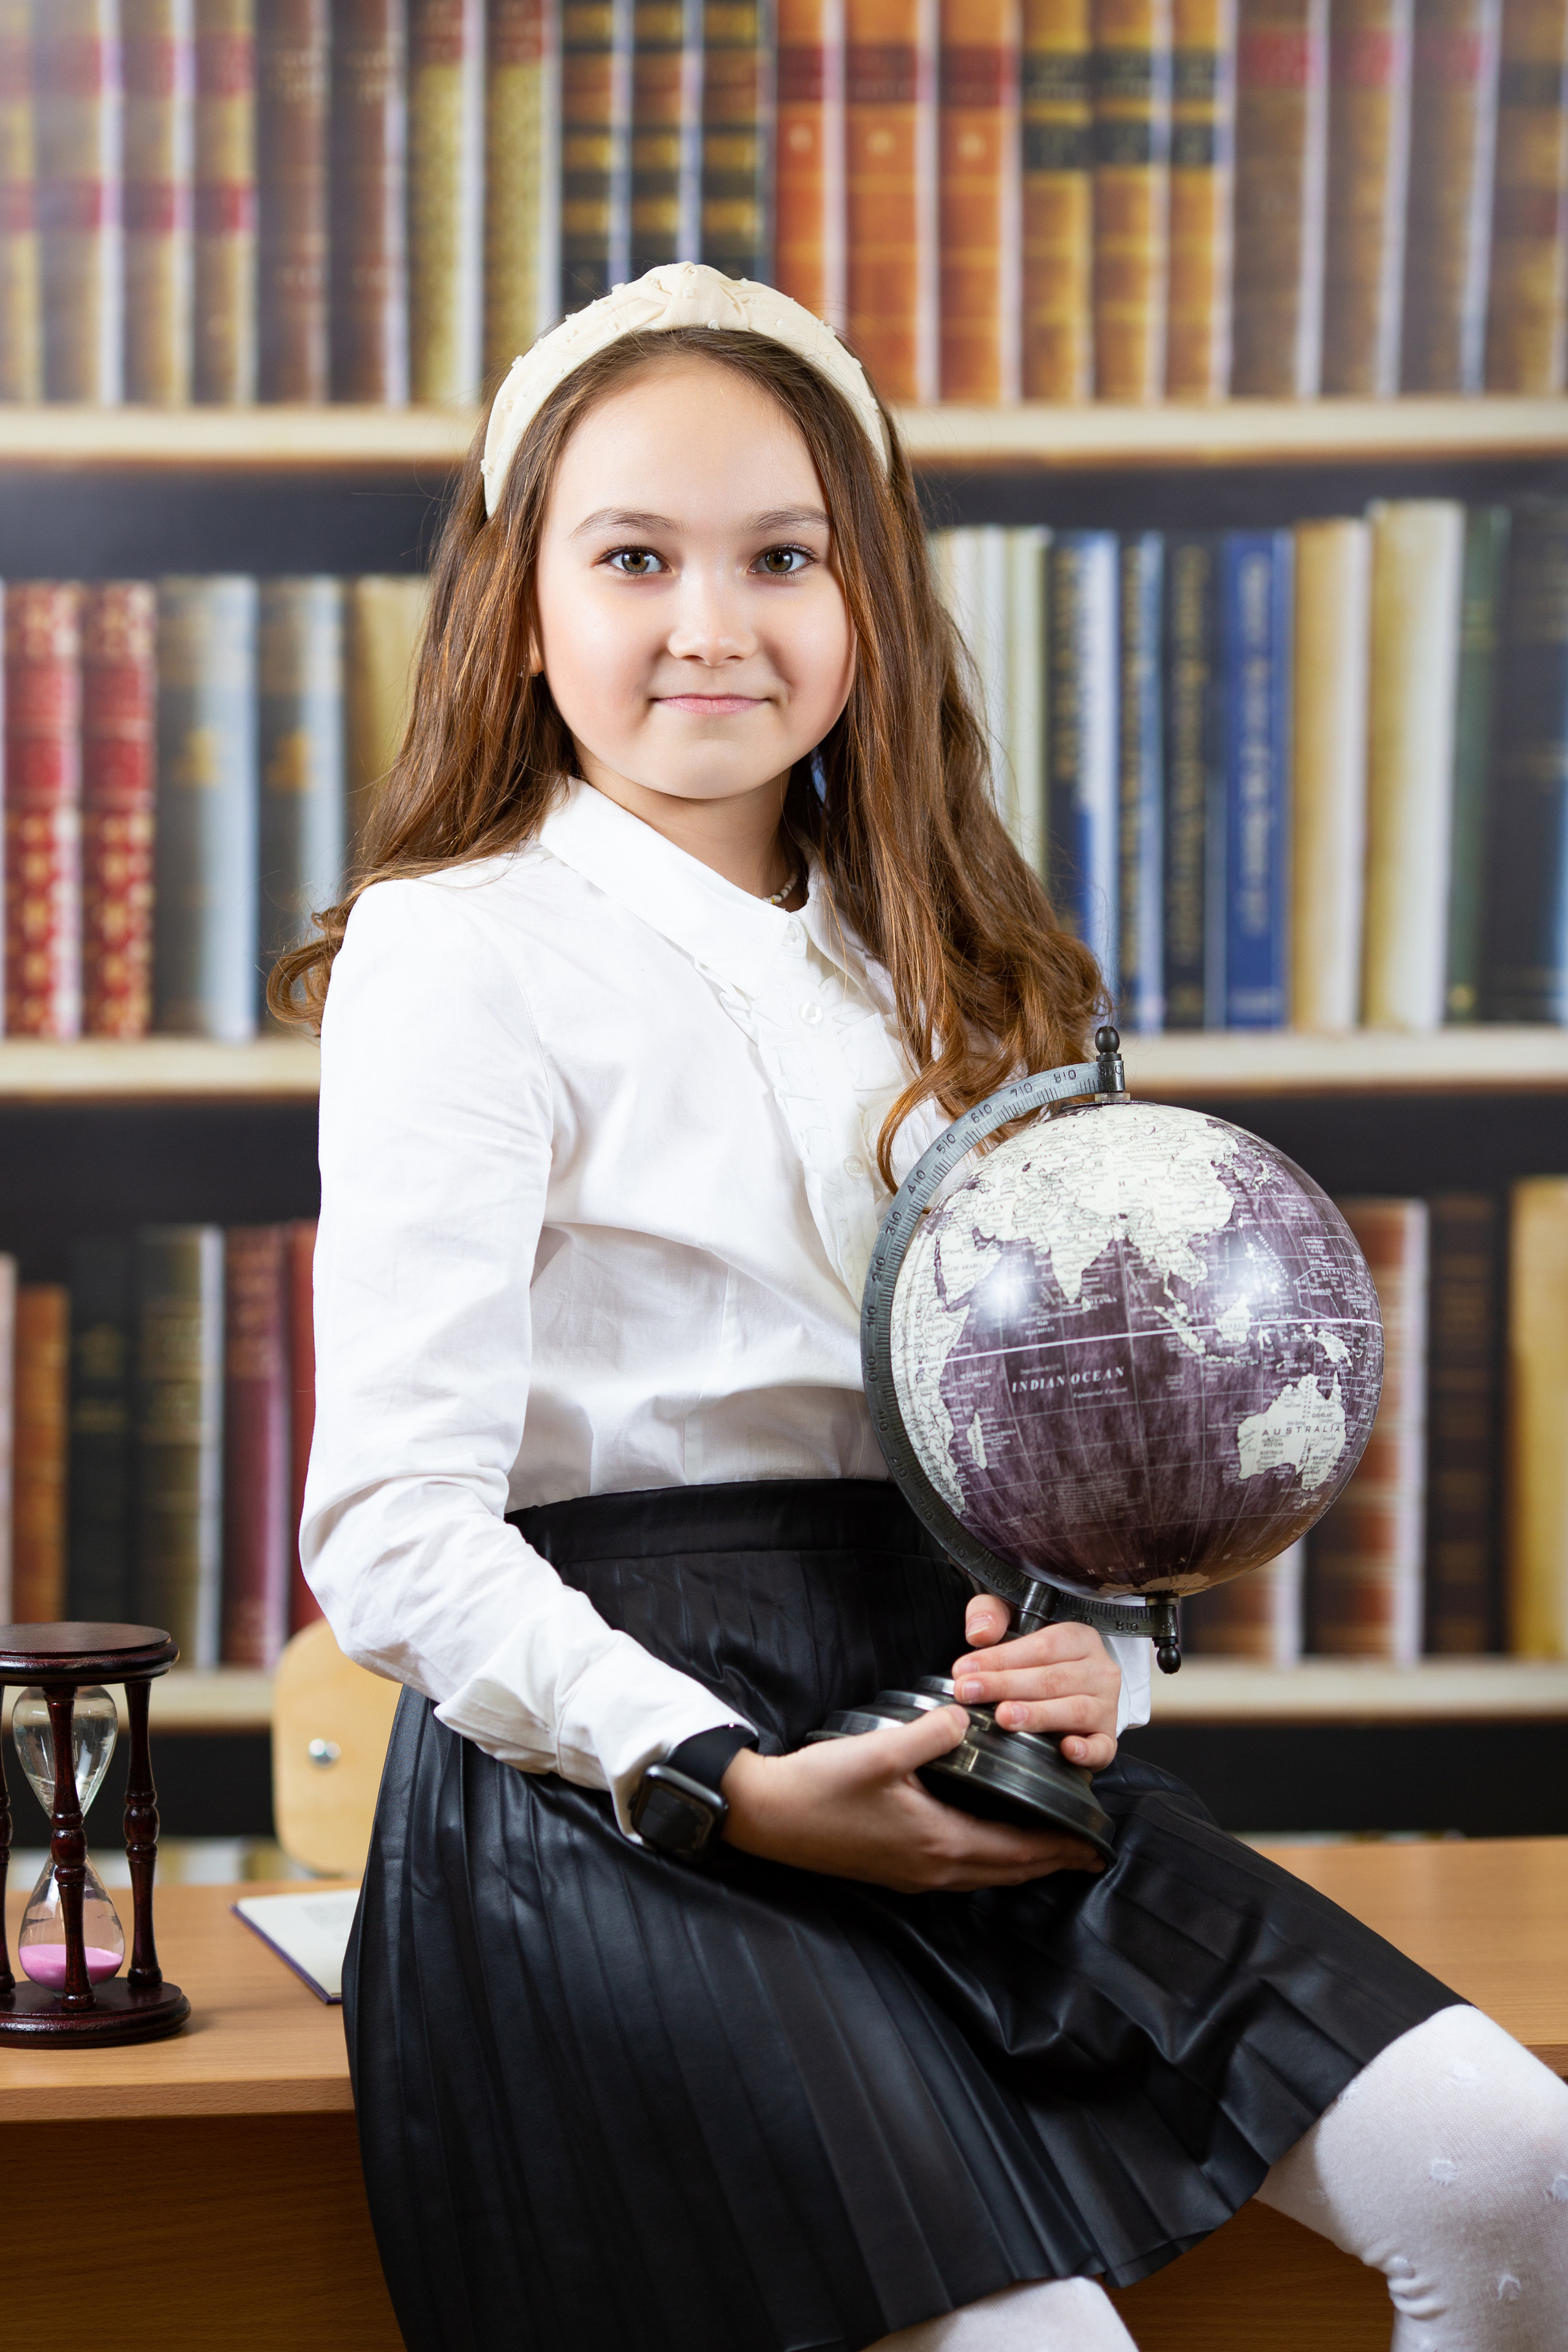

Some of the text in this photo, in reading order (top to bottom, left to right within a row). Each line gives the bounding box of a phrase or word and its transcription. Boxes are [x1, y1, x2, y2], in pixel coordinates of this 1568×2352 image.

[1012, 1374, 1066, 1393] INDIAN
[1070, 1366, 1125, 1385] OCEAN
[1262, 1425, 1340, 1437] AUSTRALIA
